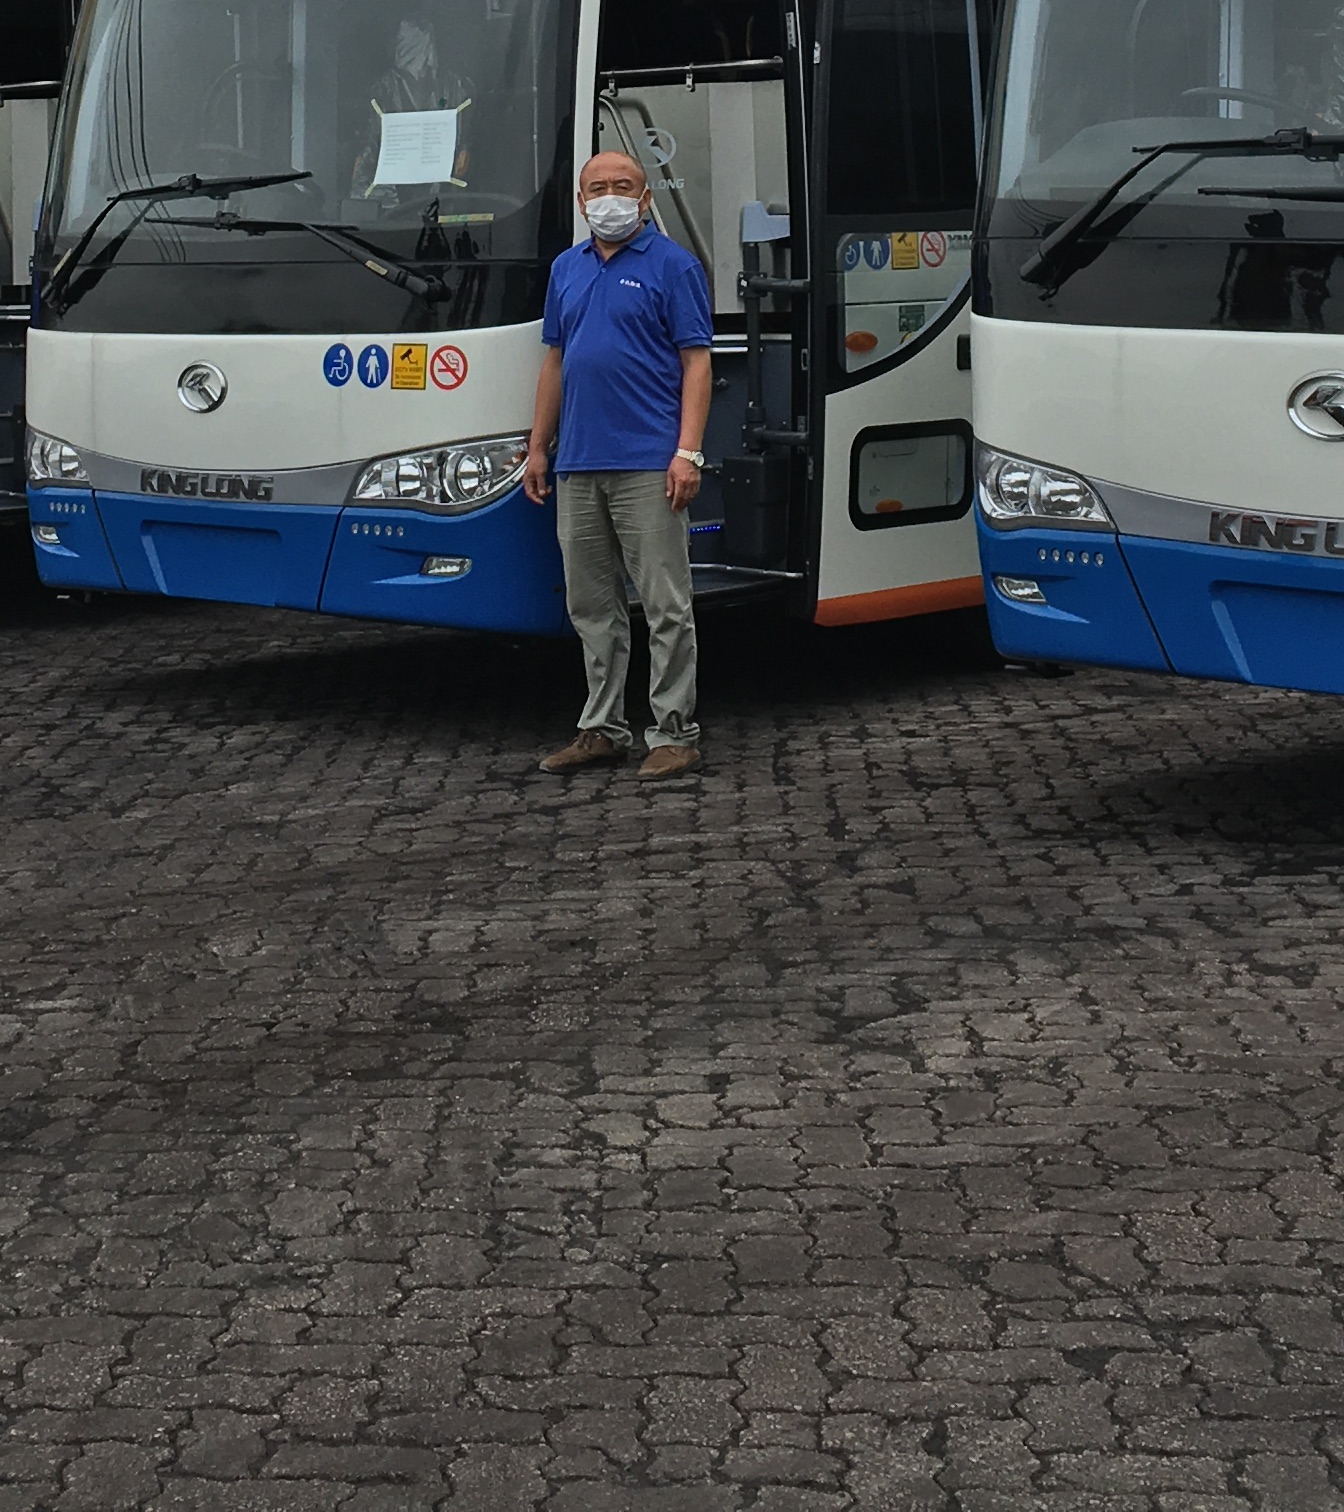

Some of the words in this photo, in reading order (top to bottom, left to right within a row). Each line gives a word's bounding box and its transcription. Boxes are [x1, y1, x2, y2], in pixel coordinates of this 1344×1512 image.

[140, 468, 199, 497] KING
[200, 472, 275, 502] LONG
[1208, 510, 1319, 552] KING
